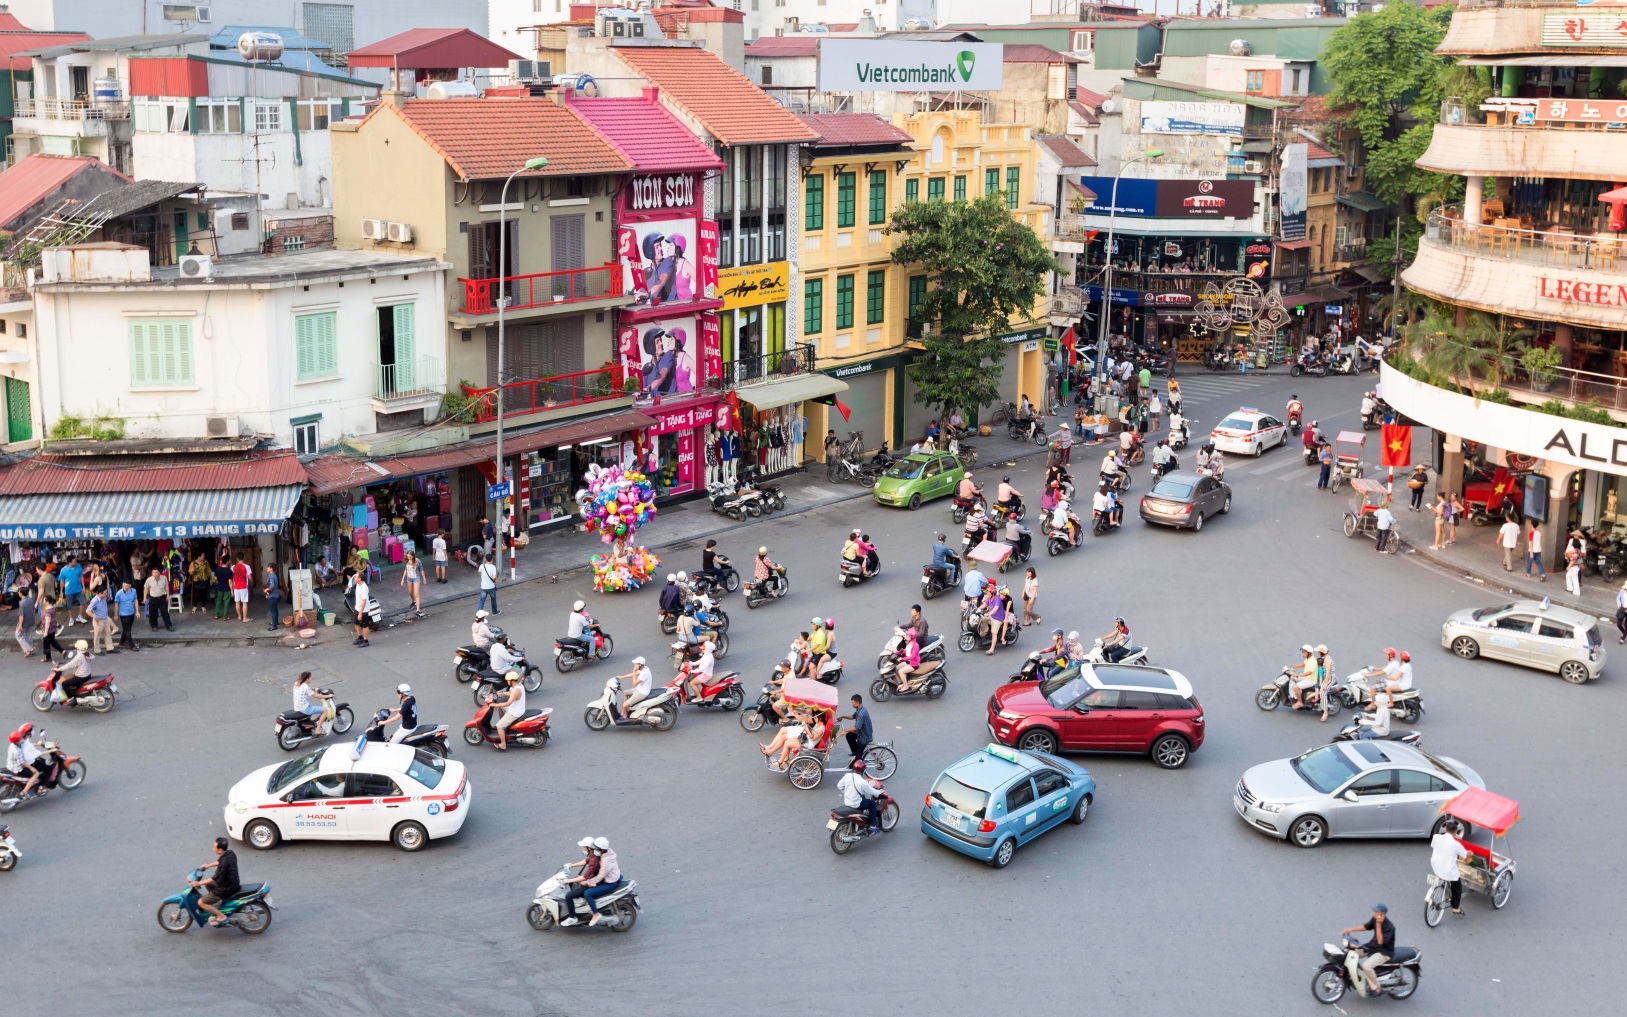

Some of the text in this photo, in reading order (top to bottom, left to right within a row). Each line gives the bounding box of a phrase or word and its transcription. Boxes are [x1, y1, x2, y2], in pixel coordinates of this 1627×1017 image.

[857, 63, 956, 82] Vietcombank
[633, 173, 694, 210] NÓN SƠN
[1198, 199, 1226, 207] TRANG
[836, 363, 872, 377] Vietcombank
[687, 410, 694, 425] 1
[683, 440, 688, 450] 1
[683, 464, 688, 475] 1
[43, 527, 67, 539] ÁO
[109, 527, 134, 538] EM
[153, 525, 187, 536] 113
[192, 523, 239, 535] HÀNG
